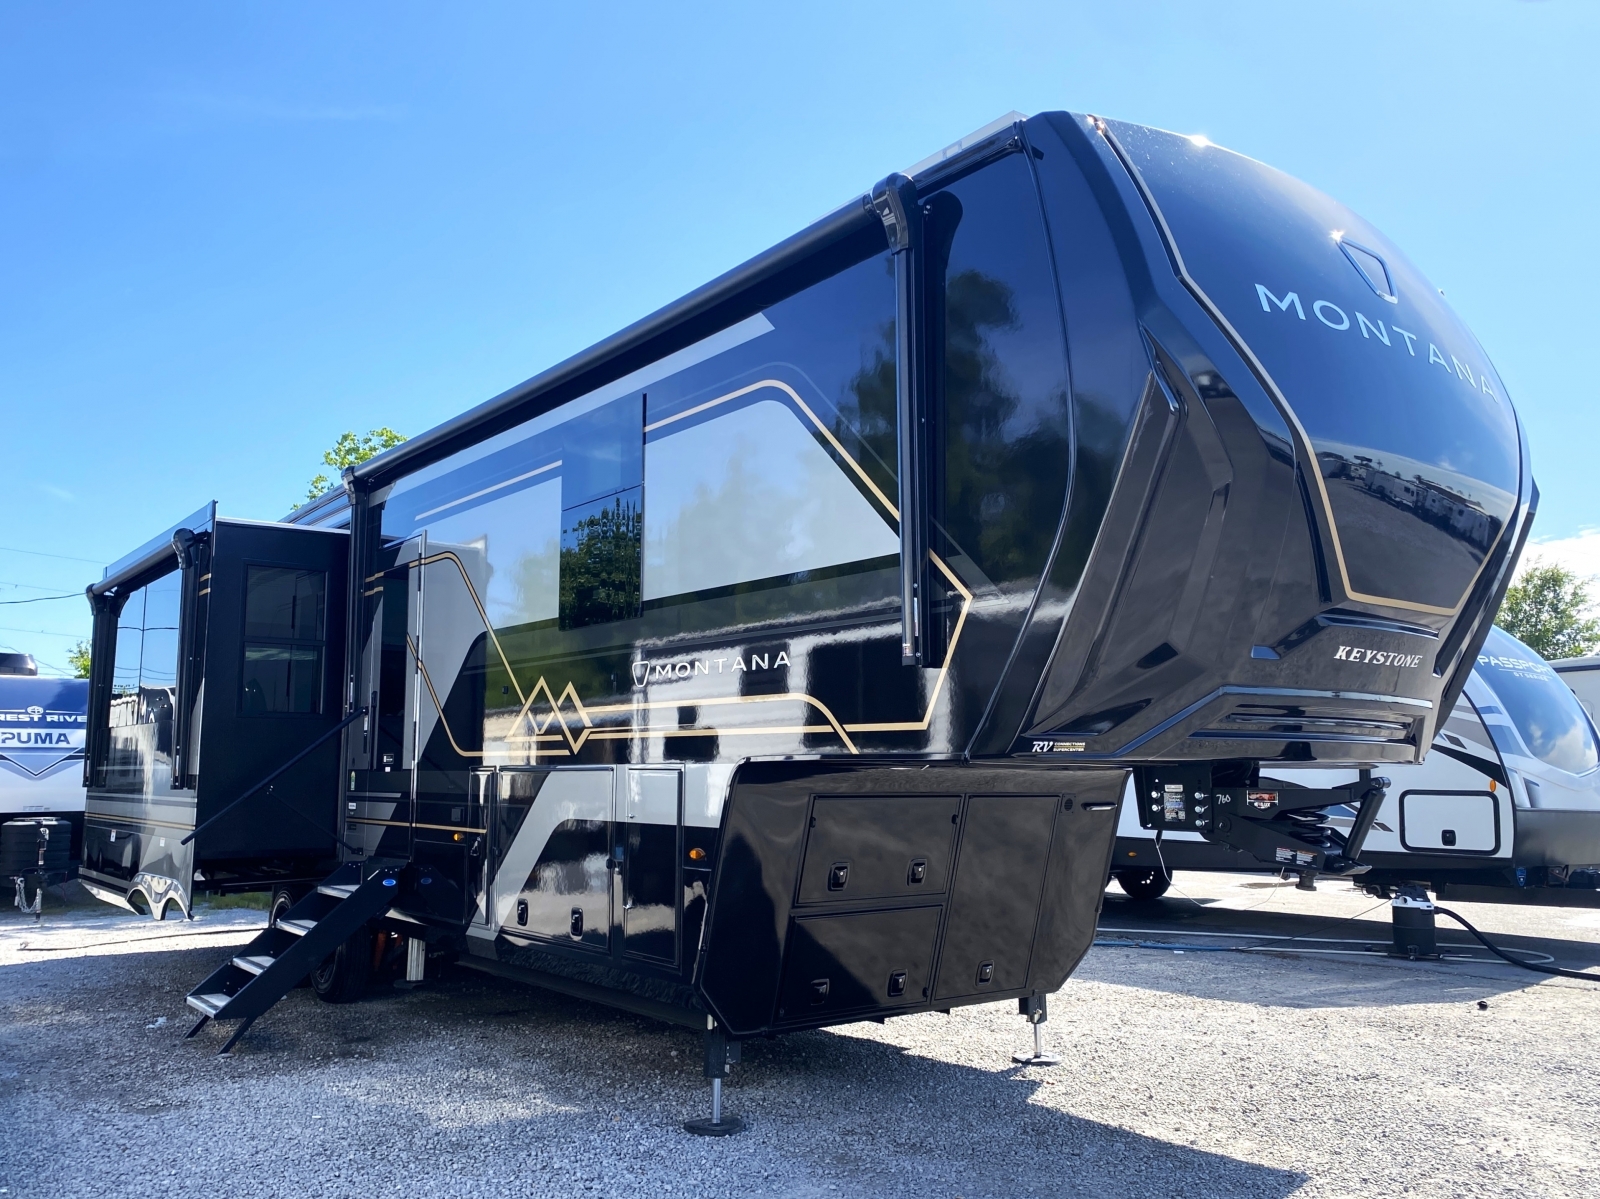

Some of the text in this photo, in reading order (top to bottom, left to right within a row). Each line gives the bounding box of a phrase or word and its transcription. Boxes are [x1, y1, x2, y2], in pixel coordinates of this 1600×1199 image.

[1254, 283, 1498, 404] MONTANA
[655, 651, 792, 680] MONTANA
[1334, 645, 1423, 669] KEYSTONE
[0, 731, 71, 745] PUMA
[1031, 740, 1054, 753] RV
